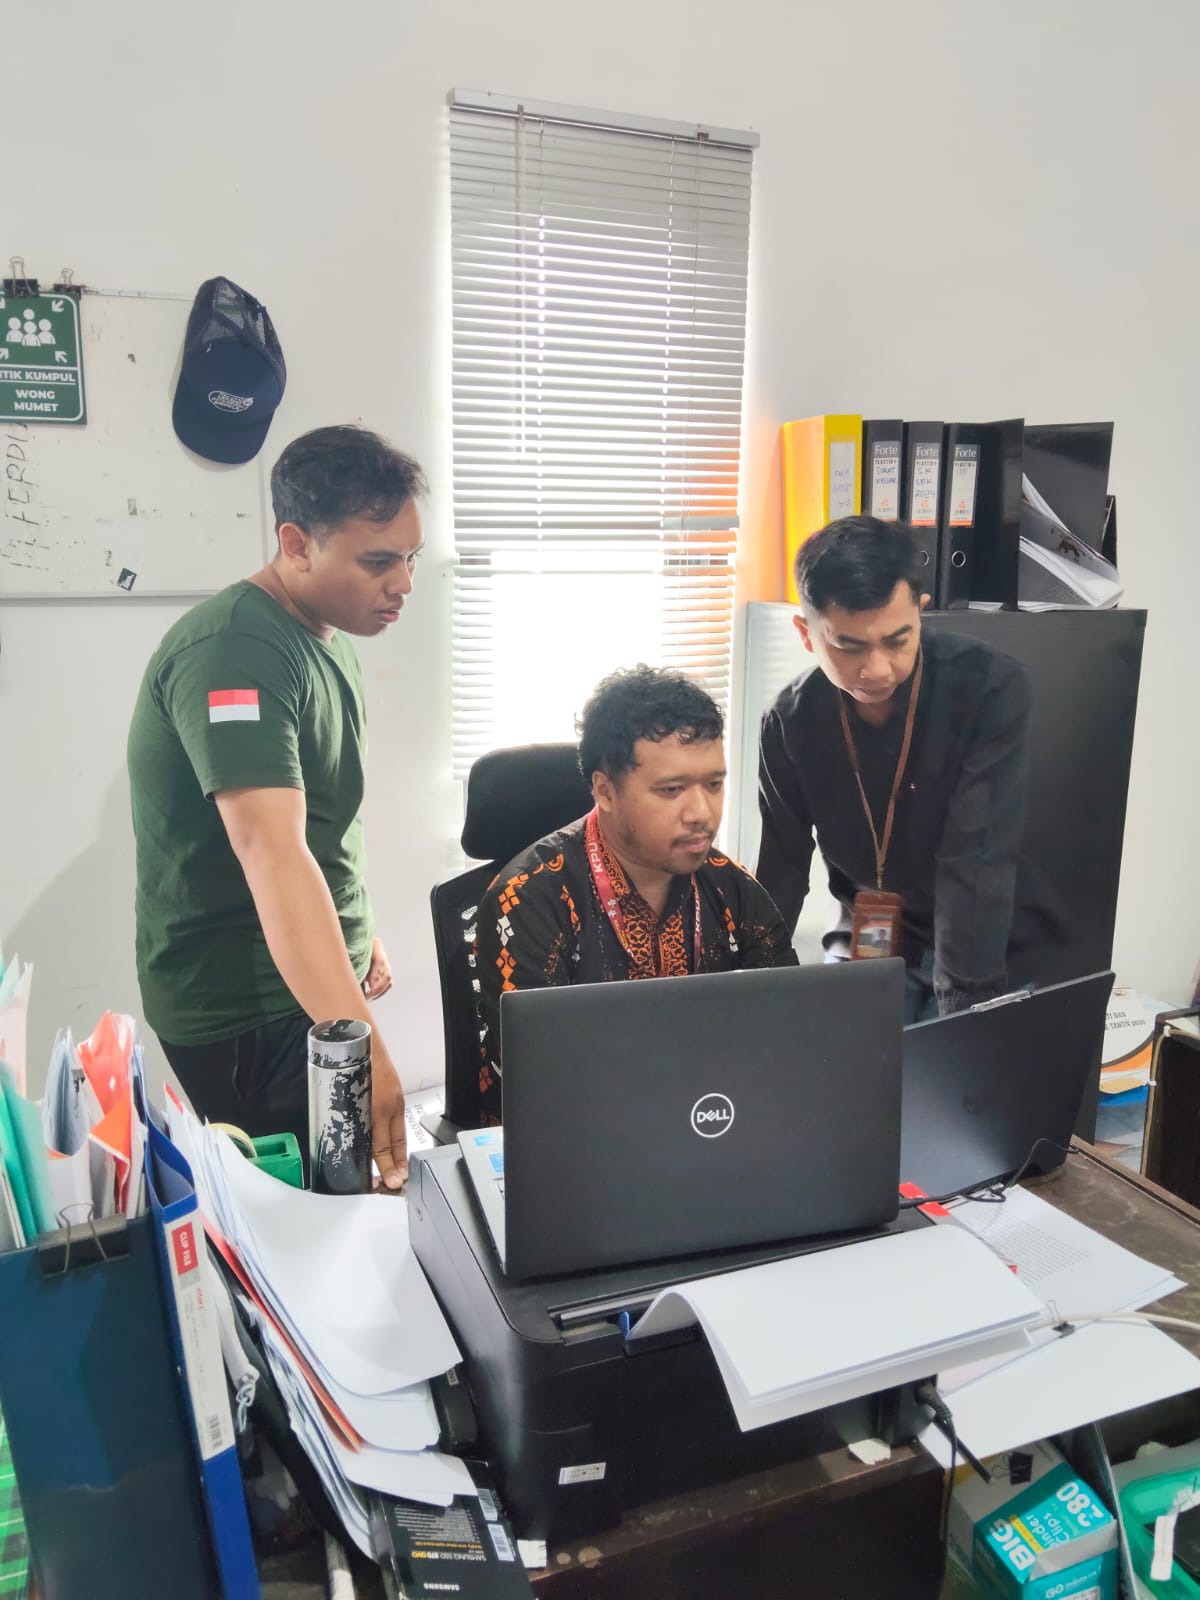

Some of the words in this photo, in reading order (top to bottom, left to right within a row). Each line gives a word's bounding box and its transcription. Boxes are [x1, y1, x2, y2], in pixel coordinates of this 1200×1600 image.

[0, 370, 22, 380] ITIK
[25, 371, 76, 382] KUMPUL
[15, 389, 56, 399] WONG
[14, 402, 59, 412] MUMET
[874, 444, 898, 456] Forte
[916, 446, 938, 457] Forte
[955, 447, 977, 458] Forte
[588, 842, 604, 873] KPU
[697, 1109, 730, 1123] DELL
[180, 1231, 190, 1249] CLIP
[182, 1250, 192, 1267] FILE
[1043, 1512, 1070, 1544] Clips
